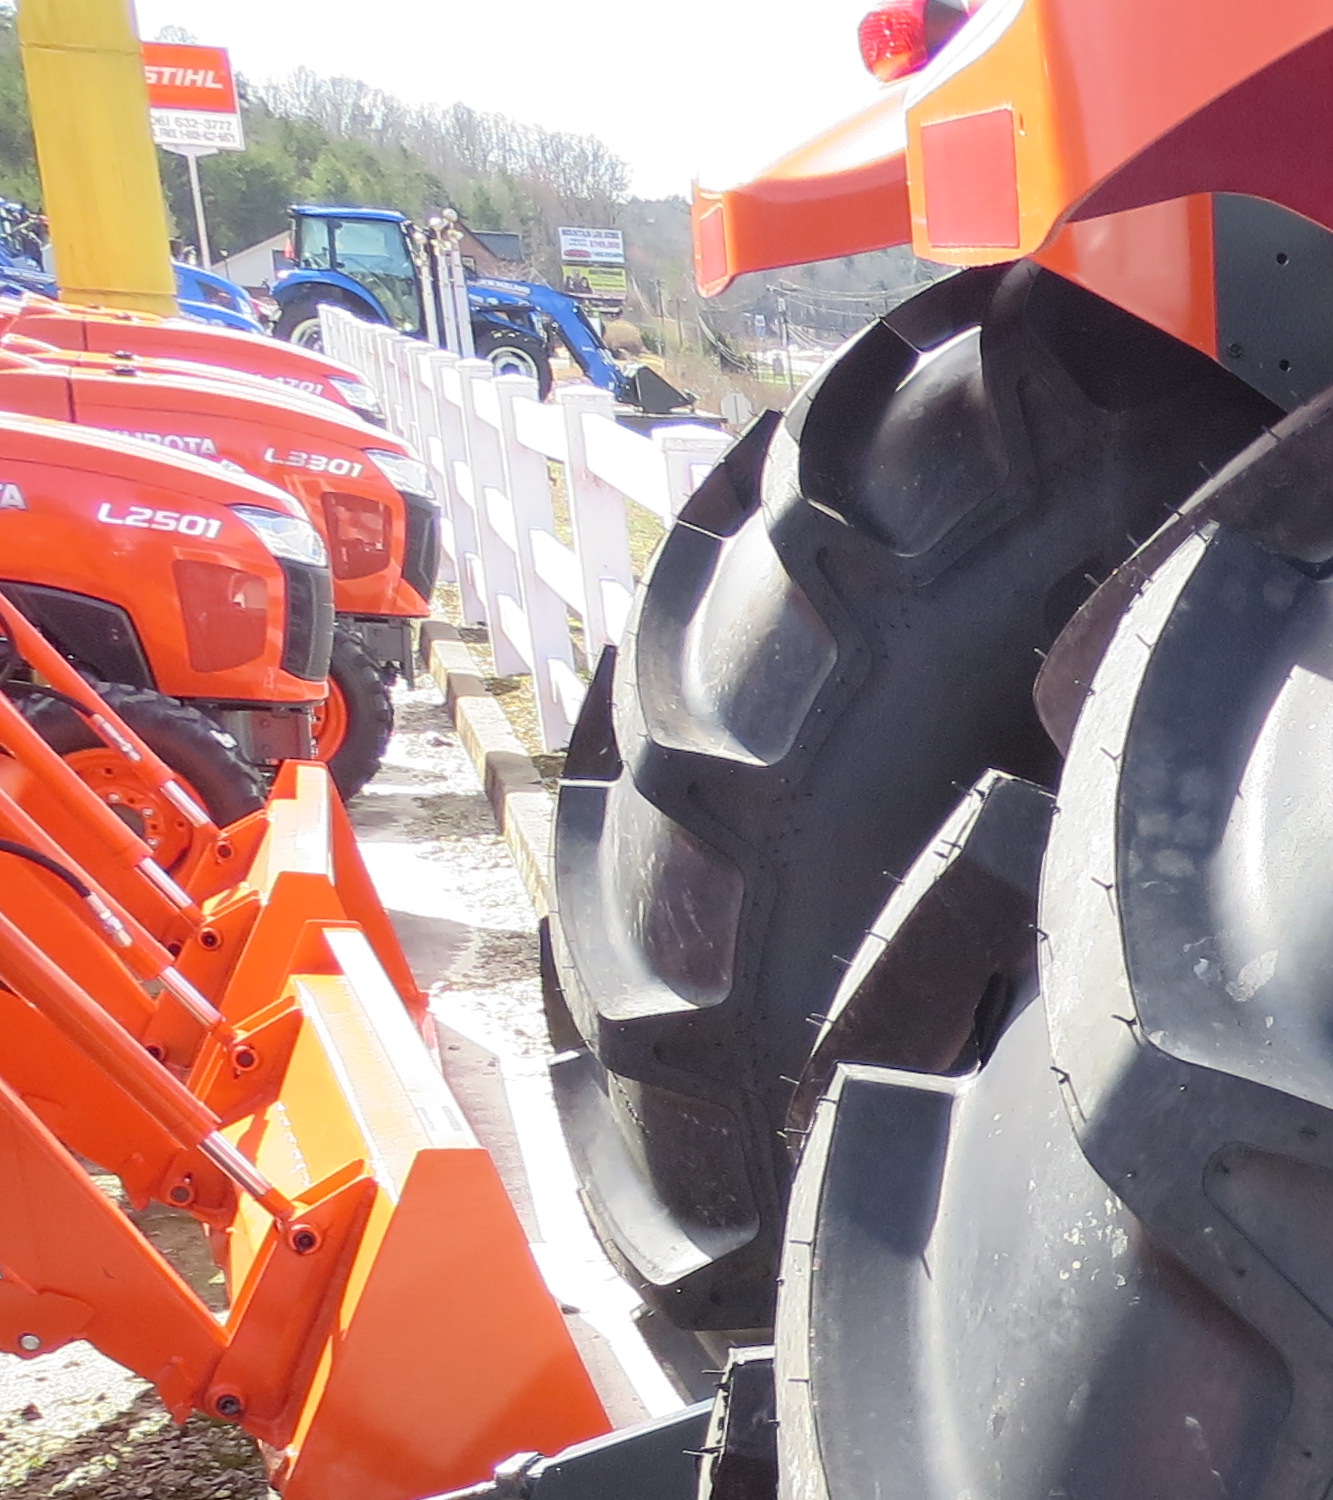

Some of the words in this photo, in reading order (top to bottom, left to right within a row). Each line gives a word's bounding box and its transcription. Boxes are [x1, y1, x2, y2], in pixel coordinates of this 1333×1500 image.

[144, 66, 223, 89] STIHL
[263, 445, 364, 479] L3301
[97, 502, 222, 539] L2501
